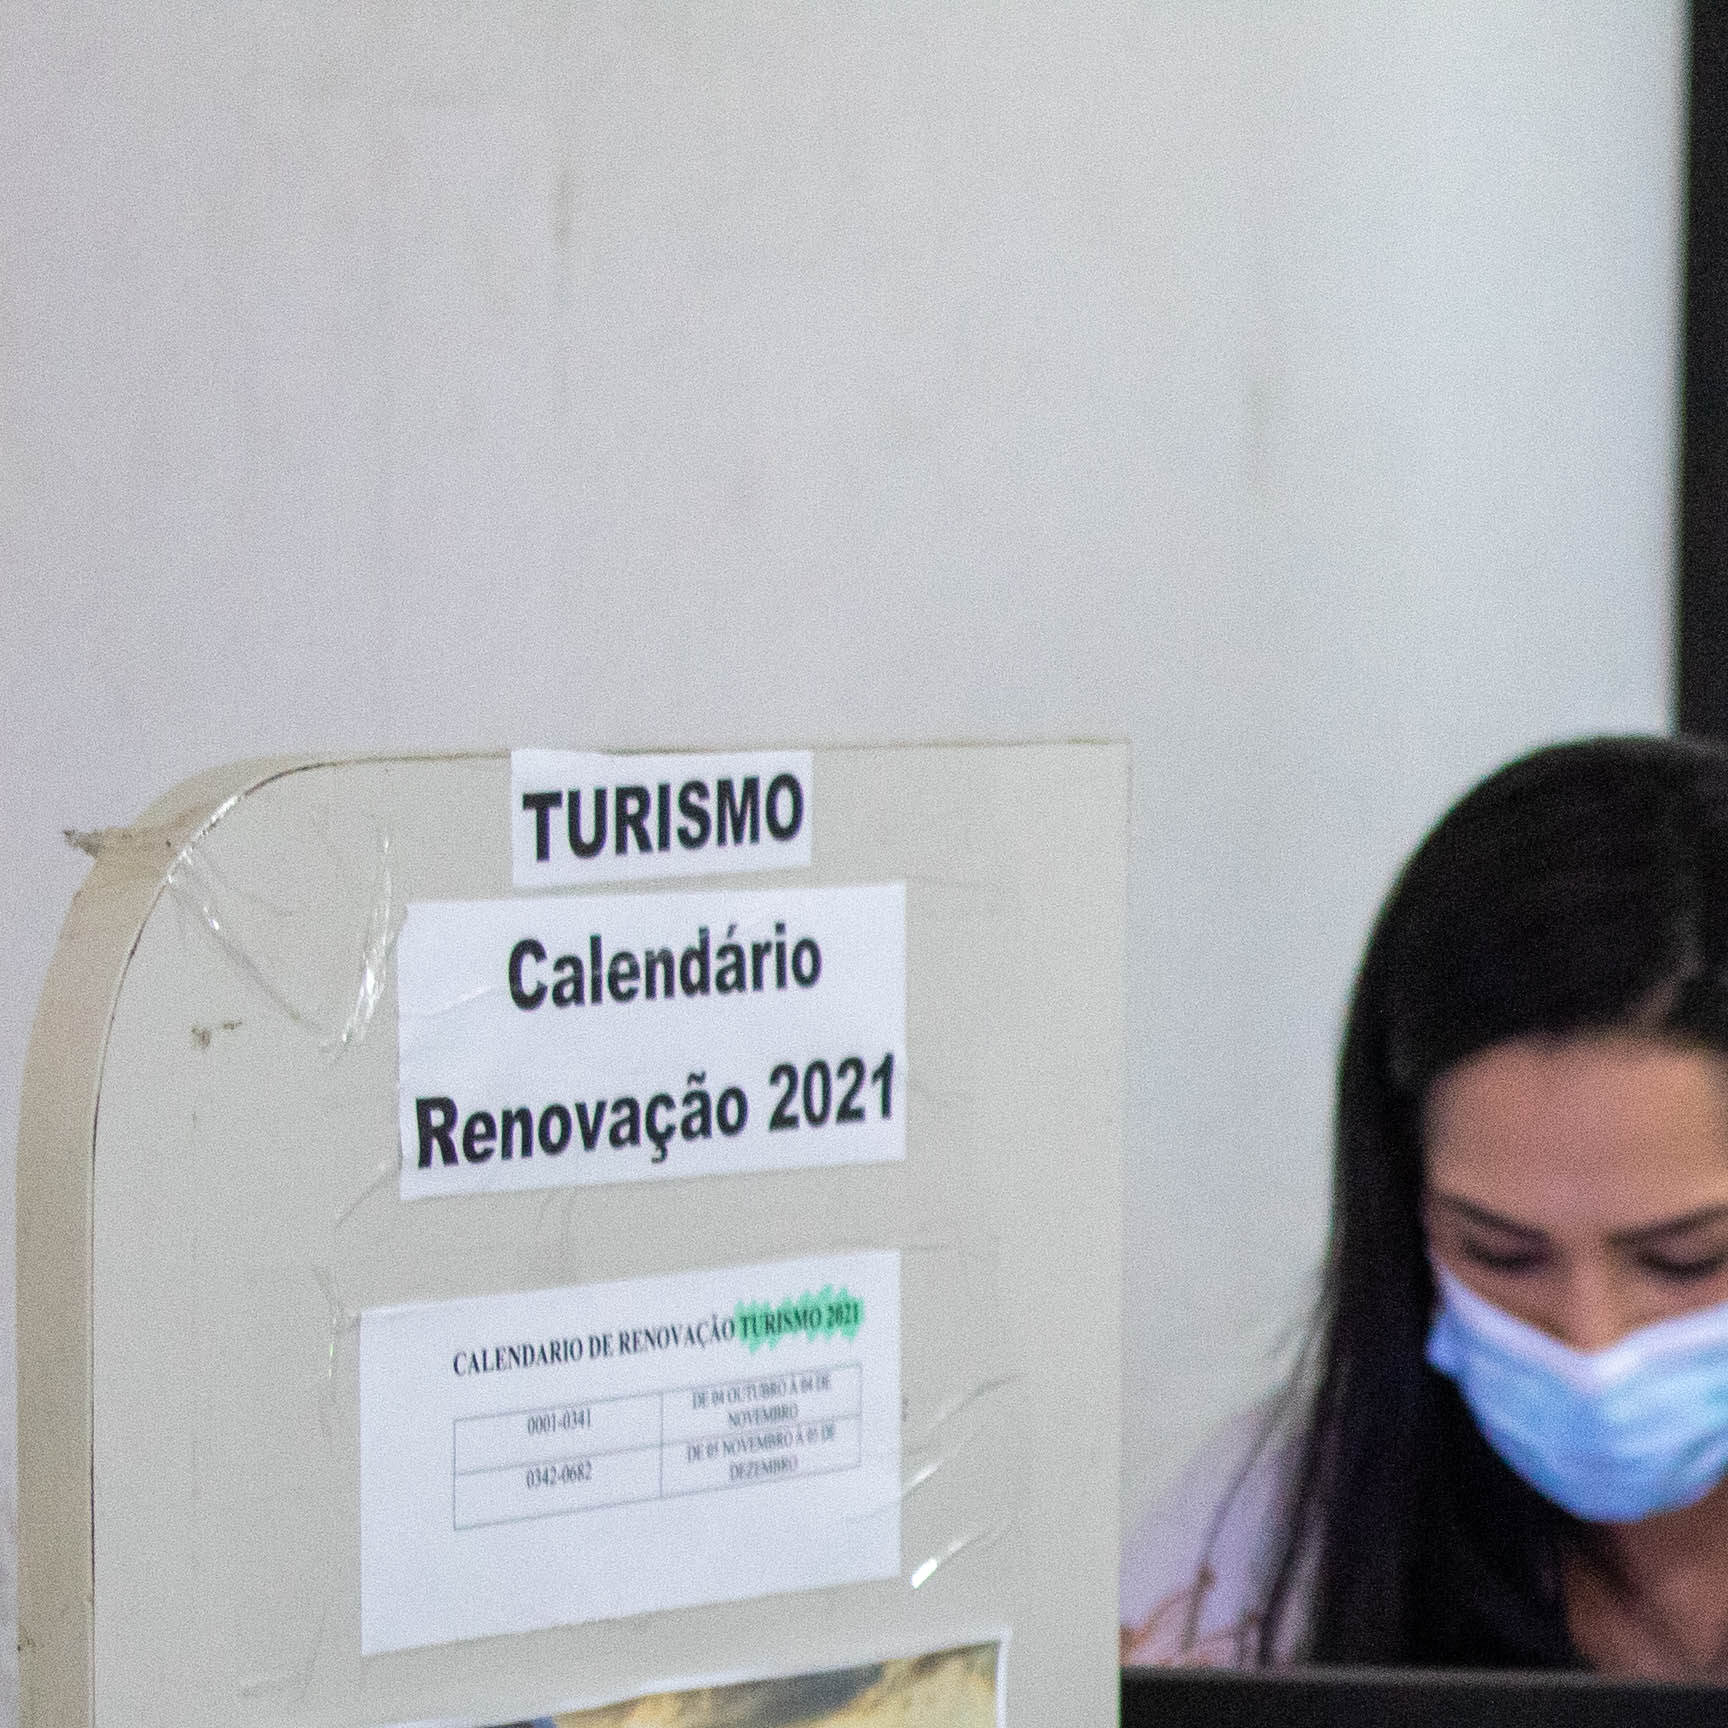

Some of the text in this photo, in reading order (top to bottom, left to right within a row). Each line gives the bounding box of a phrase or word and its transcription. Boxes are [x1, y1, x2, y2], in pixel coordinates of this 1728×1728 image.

[522, 772, 804, 861] TURISMO
[508, 922, 822, 1011] Calendário
[415, 1052, 896, 1169] Renovação 2021
[453, 1302, 859, 1376] CALENDARIO DE RENOVAÇÃO TURISMO 2021
